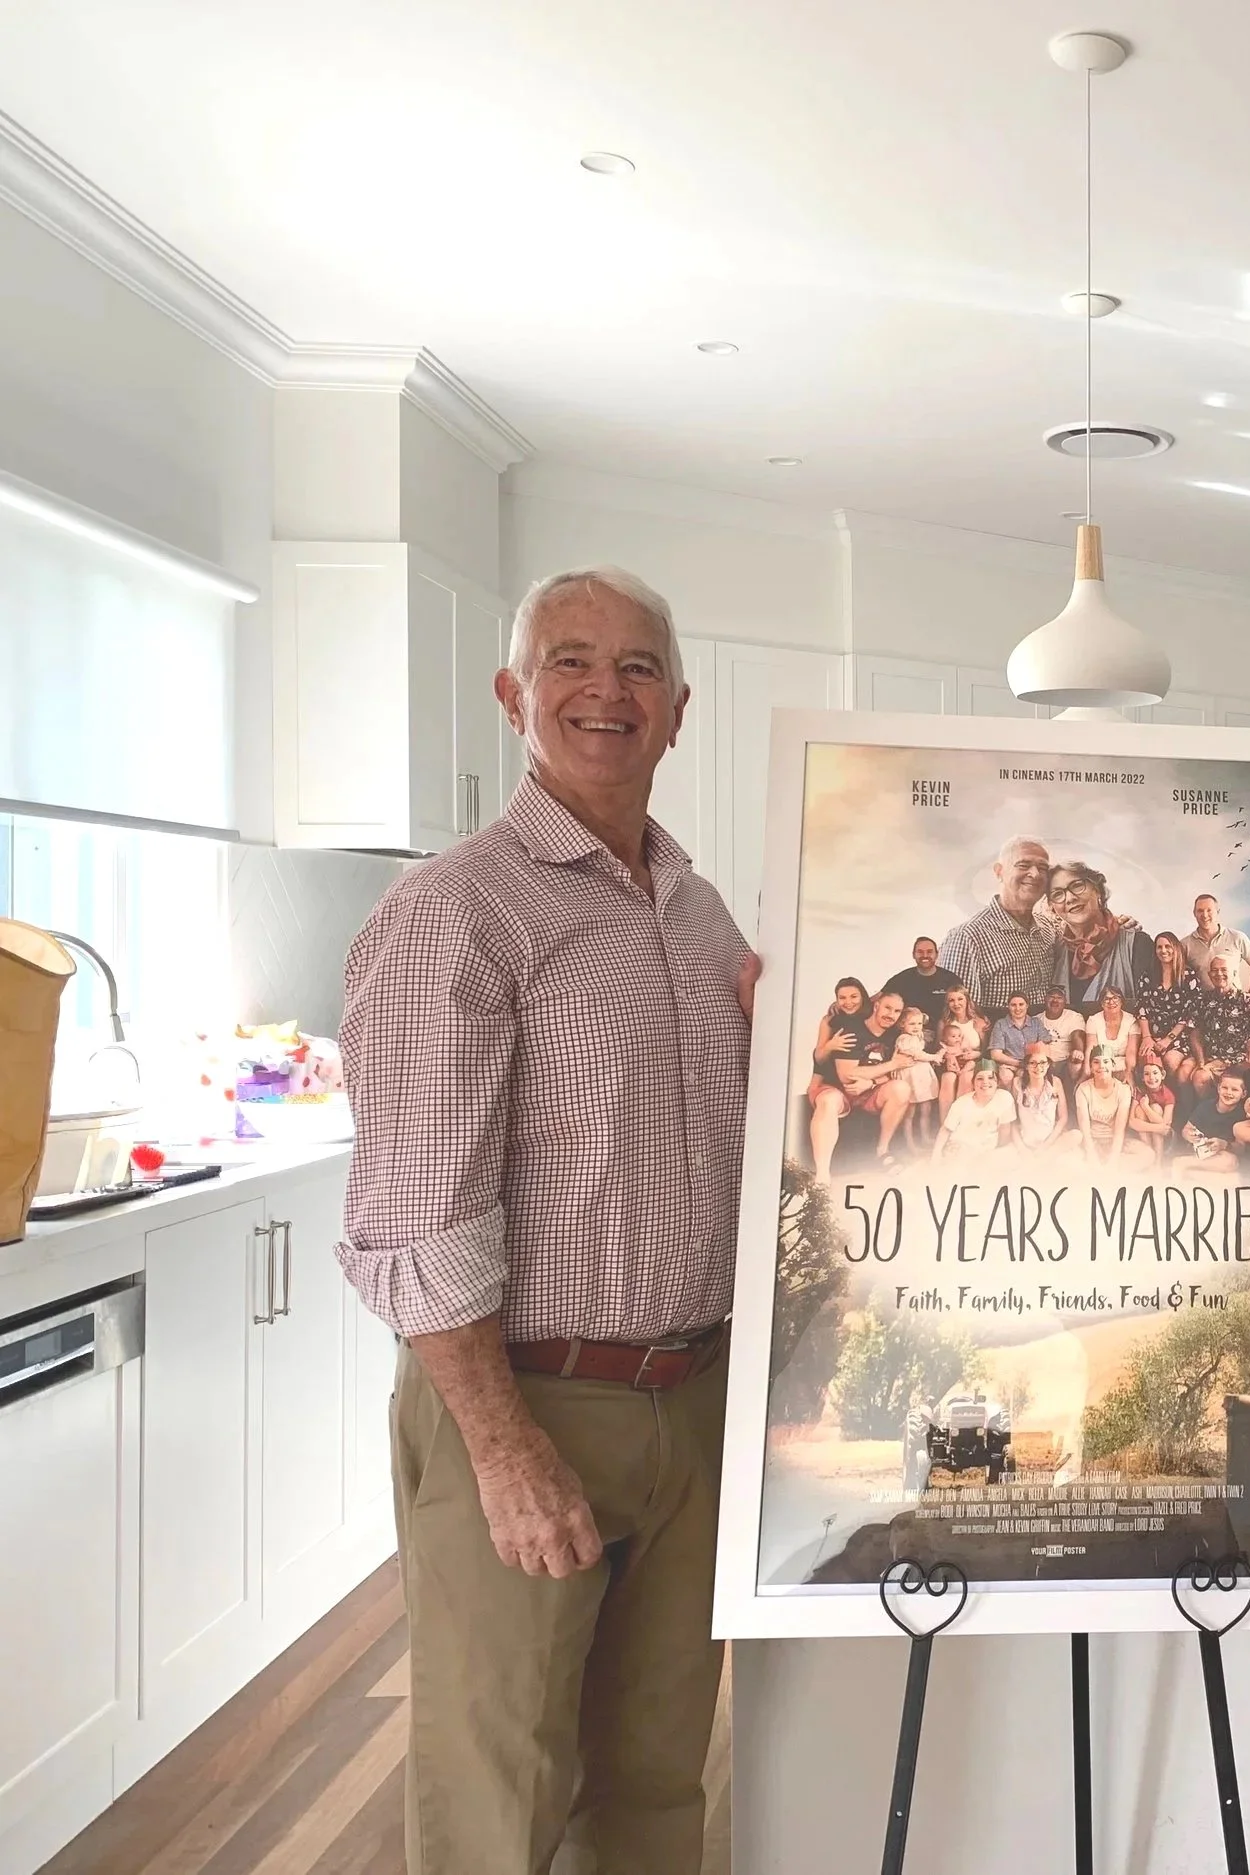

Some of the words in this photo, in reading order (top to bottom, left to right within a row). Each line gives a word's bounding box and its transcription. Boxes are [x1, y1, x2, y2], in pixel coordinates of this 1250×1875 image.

[999, 769, 1010, 780] IN
[1012, 769, 1055, 782] CINEMAS
[1058, 771, 1082, 783] 17TH
[1085, 772, 1118, 784] MARCH
[1121, 773, 1145, 785] 2022
[912, 779, 951, 794] KEVIN
[912, 793, 950, 808] PRICE
[1172, 789, 1229, 803] SUSANNE
[1183, 802, 1219, 816] PRICE
[843, 1184, 903, 1262] 50
[926, 1183, 1069, 1262] YEARS
[895, 1286, 951, 1313] Faith,
[957, 1286, 1032, 1315] Family,
[1038, 1285, 1113, 1312] Friends,
[1119, 1285, 1160, 1310] Food
[1166, 1280, 1183, 1312] &
[1190, 1285, 1229, 1310] Fun
[1204, 1485, 1217, 1499] TWIN
[1227, 1485, 1240, 1498] TWIN
[1058, 1502, 1071, 1516] TRUE
[1071, 1502, 1087, 1516] STORY
[1088, 1502, 1101, 1515] LOVE
[1101, 1502, 1118, 1515] STORY
[1174, 1501, 1187, 1514] FRED
[1188, 1501, 1202, 1514] PRICE
[996, 1519, 1009, 1533] JEAN
[1015, 1519, 1030, 1533] KEVIN
[1061, 1519, 1071, 1533] THE
[1099, 1518, 1114, 1532] BAND
[1134, 1518, 1148, 1531] LORD
[1148, 1518, 1165, 1531] JESUS
[1031, 1547, 1046, 1555] YOUR
[1046, 1546, 1063, 1557] FILM
[1064, 1546, 1087, 1555] POSTER
